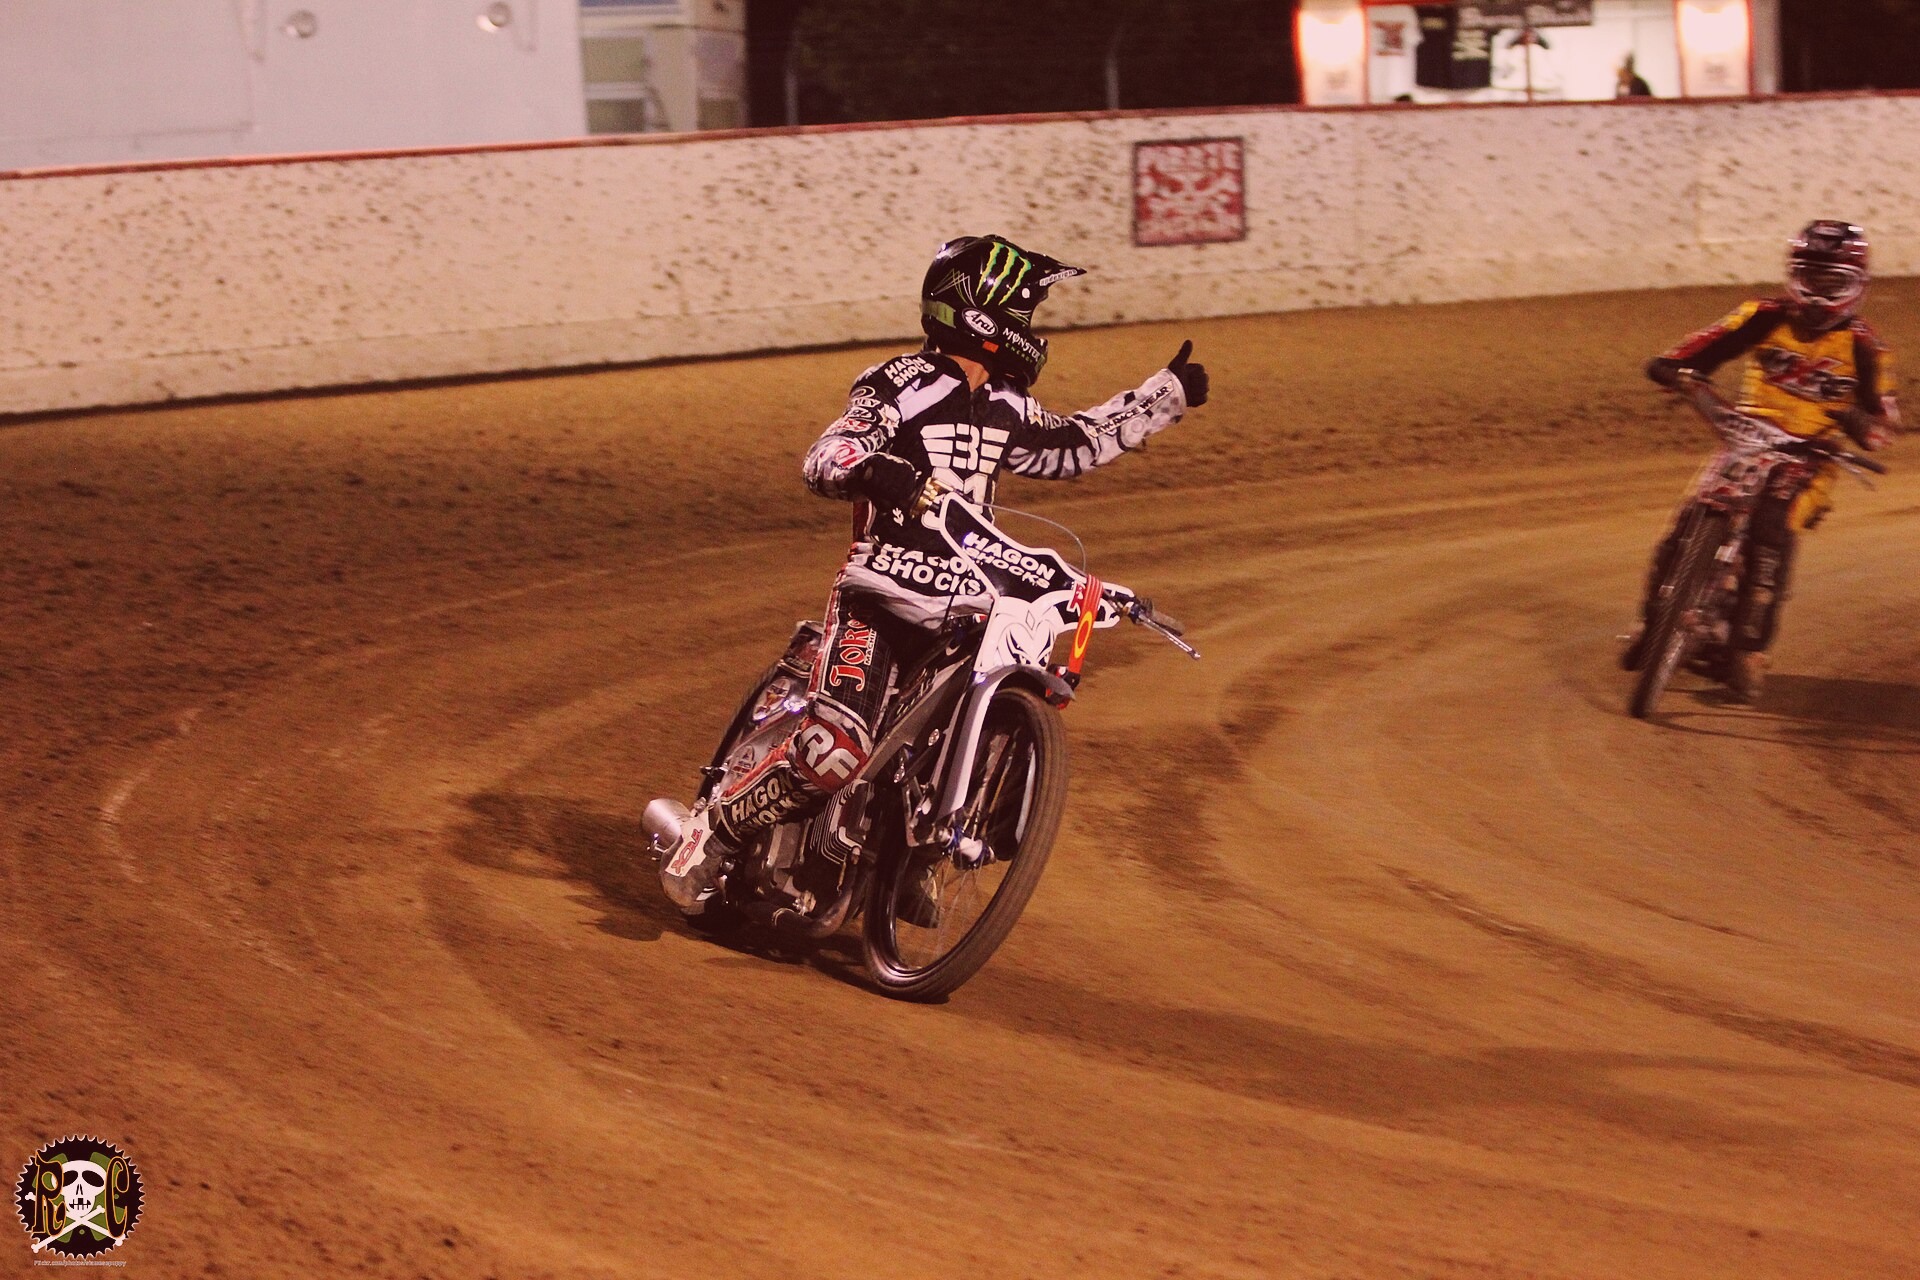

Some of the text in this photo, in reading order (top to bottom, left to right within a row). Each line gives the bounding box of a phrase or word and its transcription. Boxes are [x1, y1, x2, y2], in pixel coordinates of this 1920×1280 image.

[970, 313, 994, 333] Arai
[893, 363, 935, 387] SHOS
[872, 555, 980, 595] SHOCKS
[963, 532, 1055, 580] HAGON
[963, 548, 1050, 589] SHOCKS
